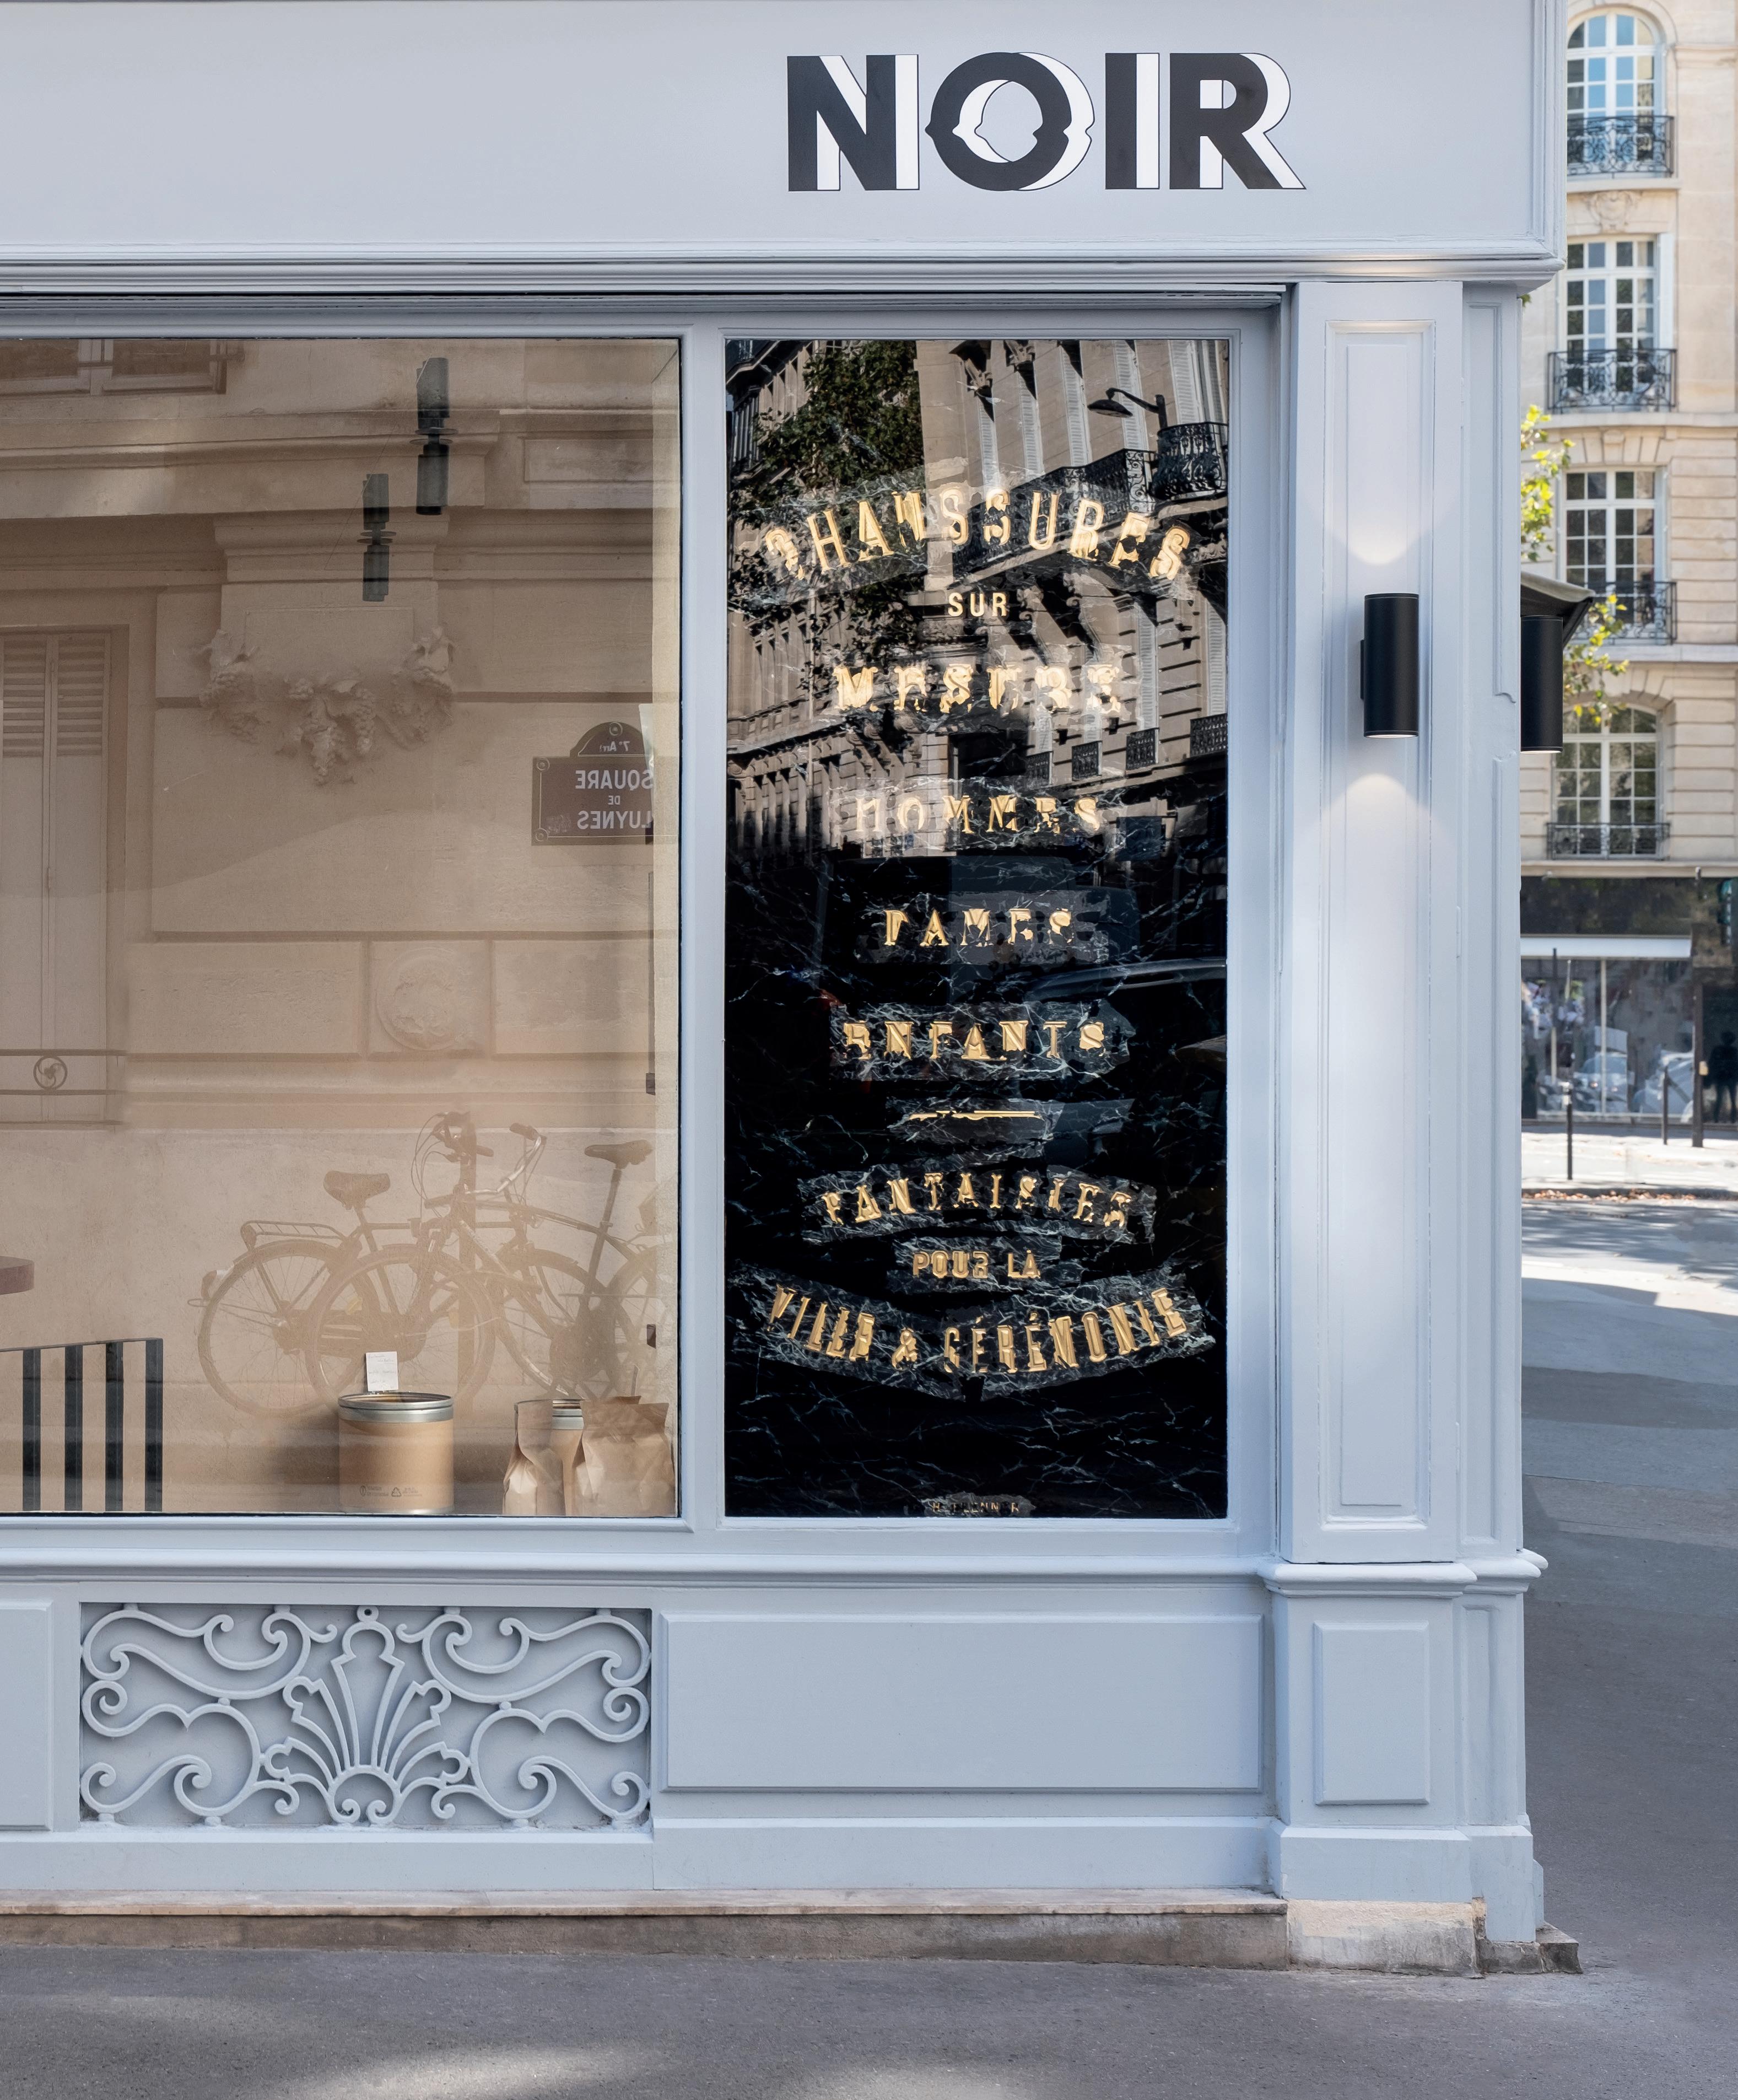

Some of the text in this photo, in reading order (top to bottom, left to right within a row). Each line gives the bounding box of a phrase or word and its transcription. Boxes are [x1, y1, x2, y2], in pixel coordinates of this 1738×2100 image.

[787, 51, 1307, 192] NOIR
[948, 592, 1007, 617] SUR
[855, 795, 1101, 834] HOMMES
[913, 1250, 989, 1279] POUR
[767, 1283, 876, 1363] VILLE
[891, 1326, 918, 1371] &
